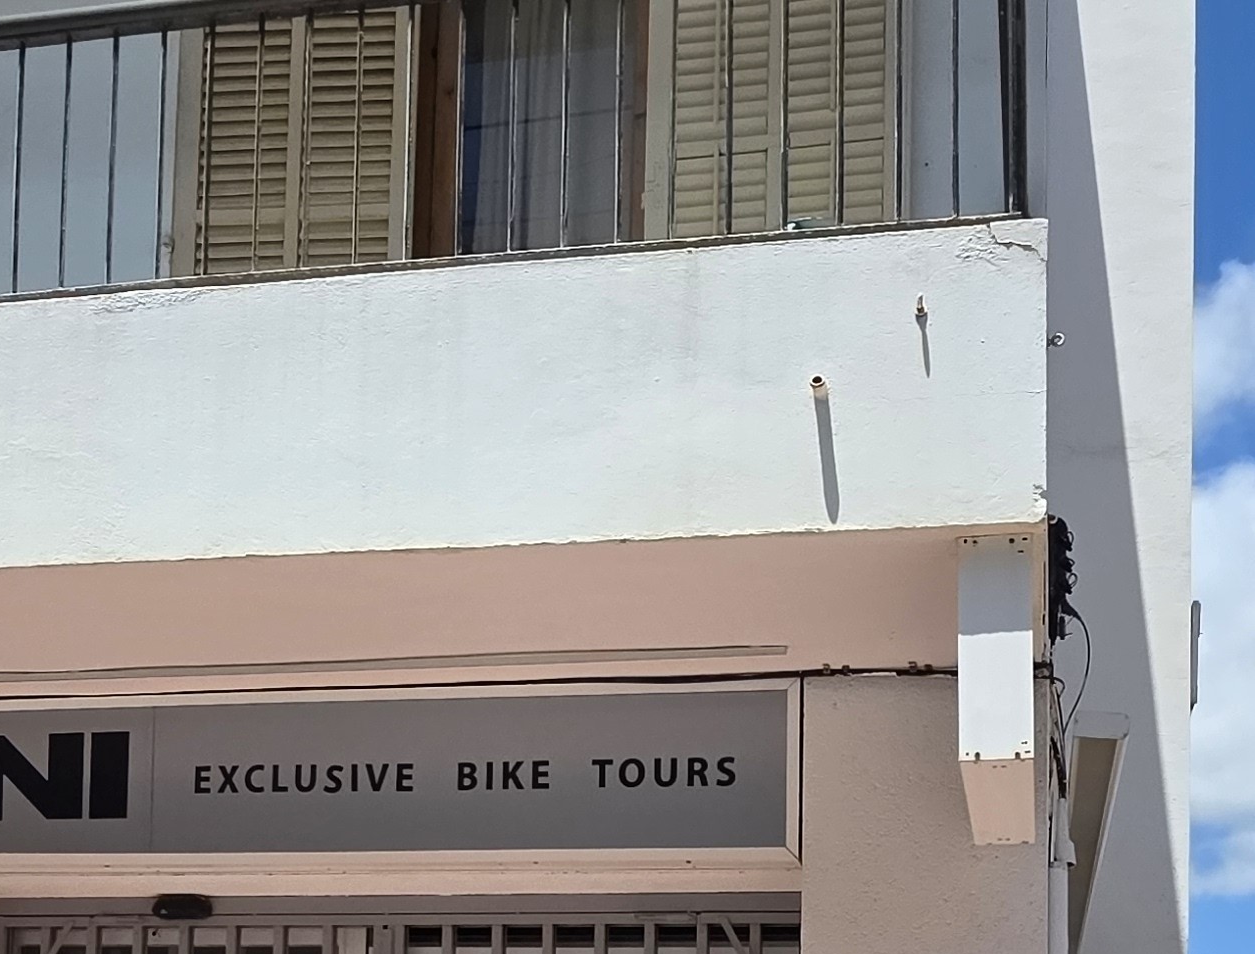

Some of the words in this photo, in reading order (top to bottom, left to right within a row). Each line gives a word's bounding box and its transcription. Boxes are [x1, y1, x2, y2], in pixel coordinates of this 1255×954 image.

[194, 763, 415, 794] EXCLUSIVE
[457, 760, 551, 791] BIKE
[591, 756, 737, 788] TOURS
